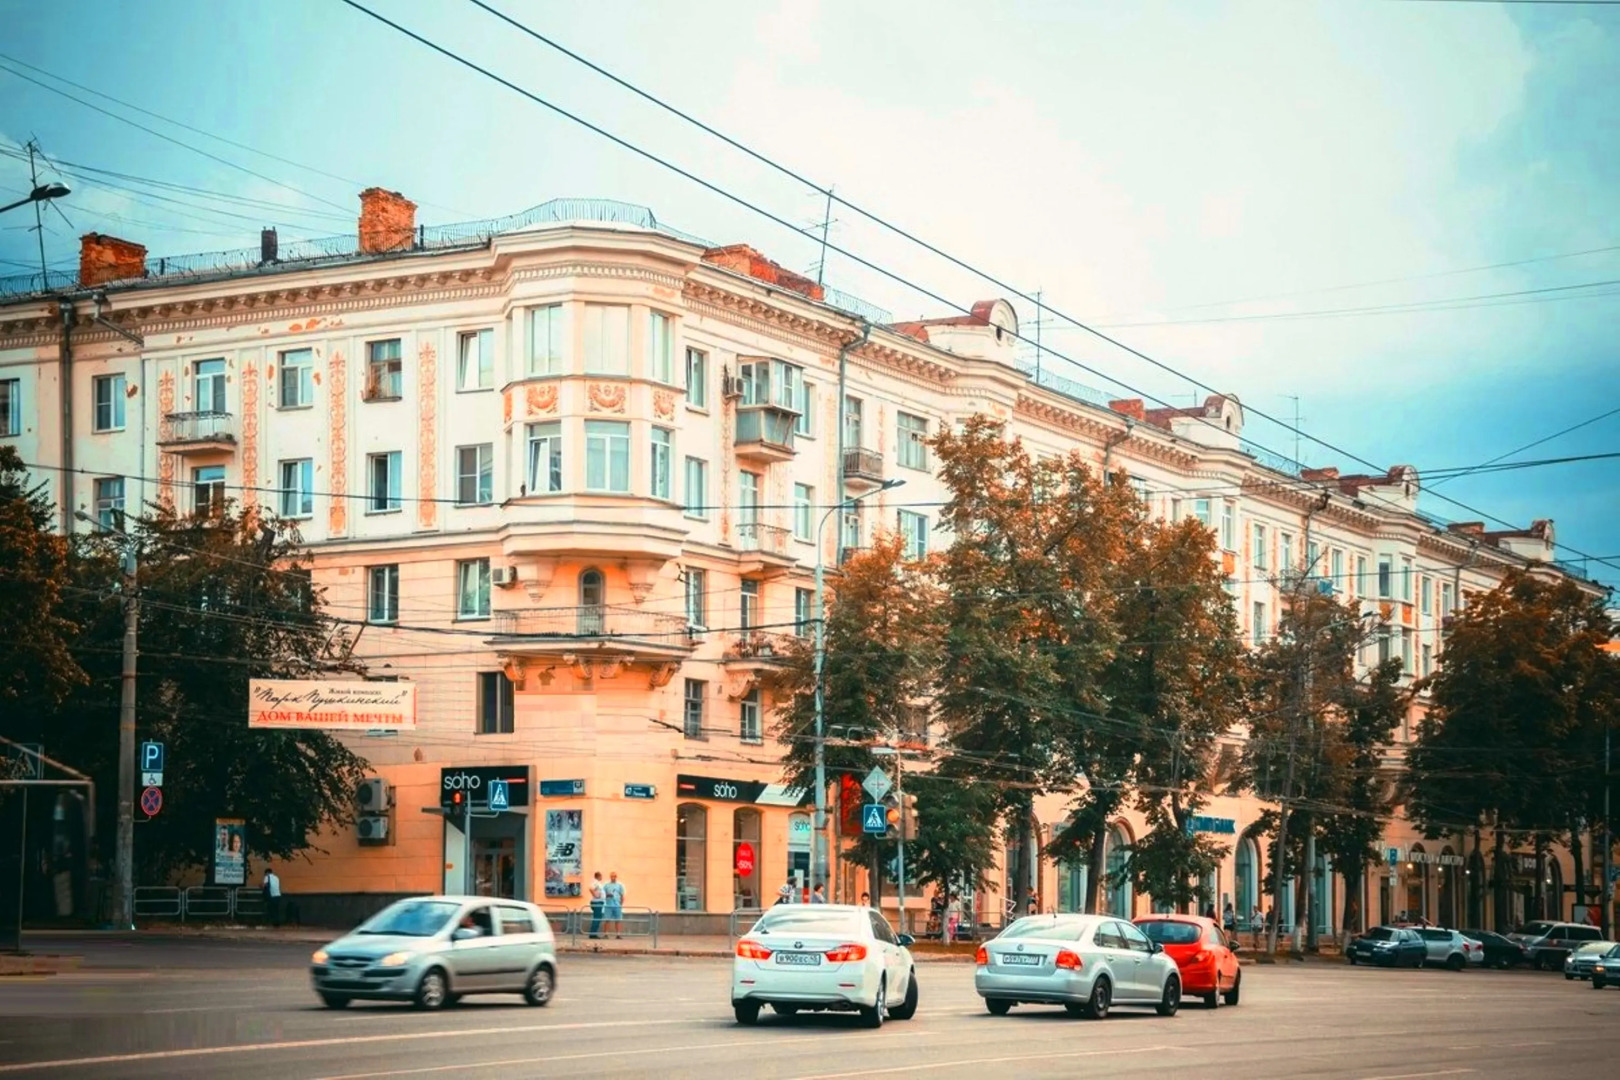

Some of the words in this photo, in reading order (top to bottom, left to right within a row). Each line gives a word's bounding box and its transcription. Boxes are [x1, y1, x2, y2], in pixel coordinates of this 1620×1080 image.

[256, 711, 292, 723] ДОМ
[294, 710, 348, 724] ВАШЕЙ
[352, 712, 404, 725] МЕЧТЫ
